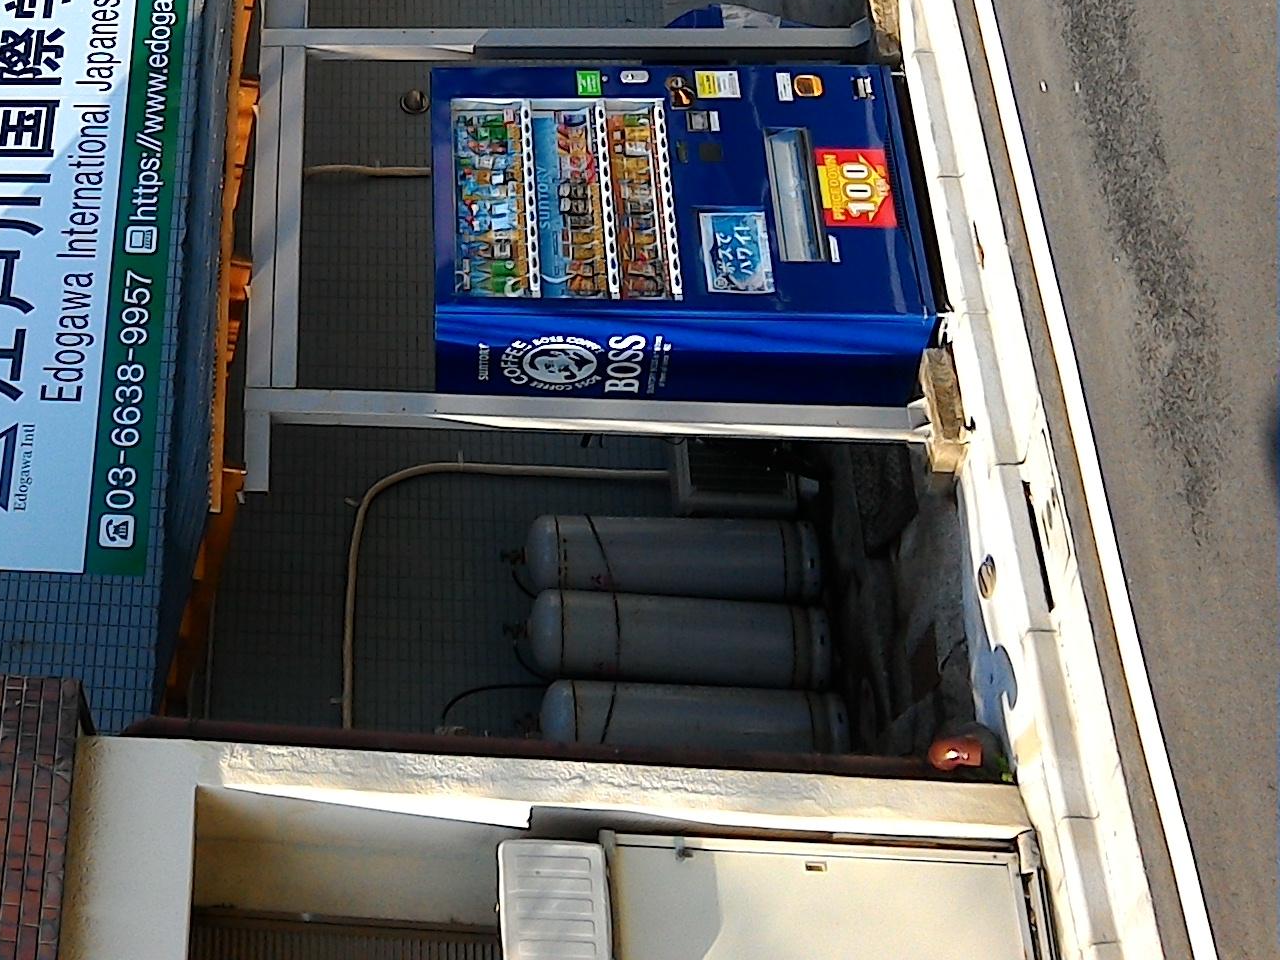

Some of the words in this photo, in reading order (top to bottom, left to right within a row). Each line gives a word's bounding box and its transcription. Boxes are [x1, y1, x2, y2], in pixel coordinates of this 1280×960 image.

[56, 104, 111, 258] International
[535, 165, 551, 229] SUNTORY
[840, 162, 877, 217] 100
[39, 272, 95, 403] Edogawa
[604, 334, 647, 393] BOSS
[105, 269, 153, 509] 03-6638-9957
[20, 423, 36, 447] Intl
[13, 451, 33, 512] Edogawa
